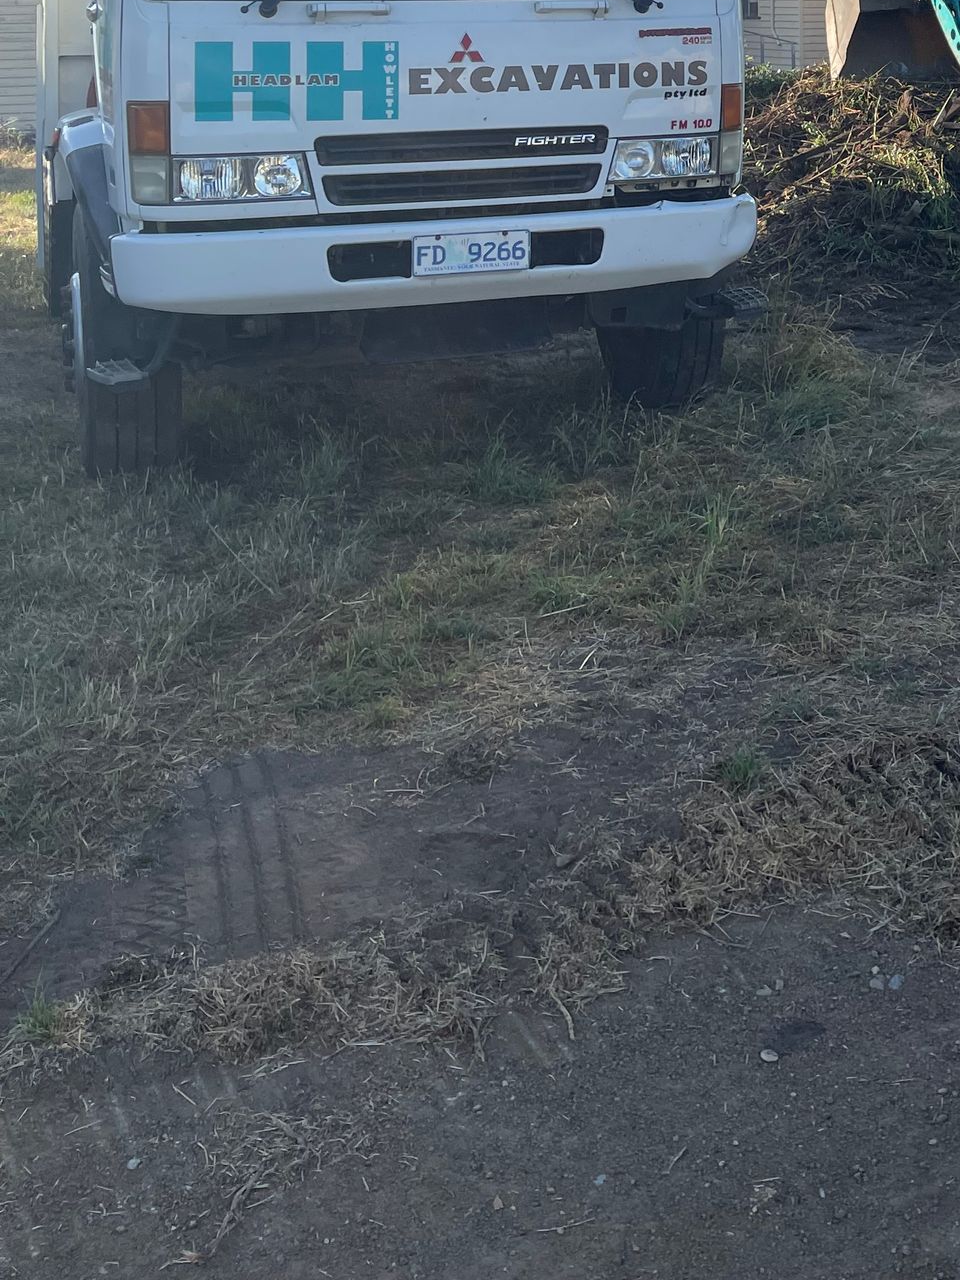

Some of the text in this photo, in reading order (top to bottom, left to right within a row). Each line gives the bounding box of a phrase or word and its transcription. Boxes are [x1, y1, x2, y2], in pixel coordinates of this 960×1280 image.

[682, 36, 700, 45] 240
[232, 74, 339, 87] HEADLAM
[383, 41, 397, 119] HOWLETT
[408, 60, 709, 96] EXCAVATIONS
[664, 88, 707, 100] pty ltd
[693, 118, 712, 129] 10.0
[514, 133, 596, 147] FIGHTER
[417, 240, 526, 266] FD 9266
